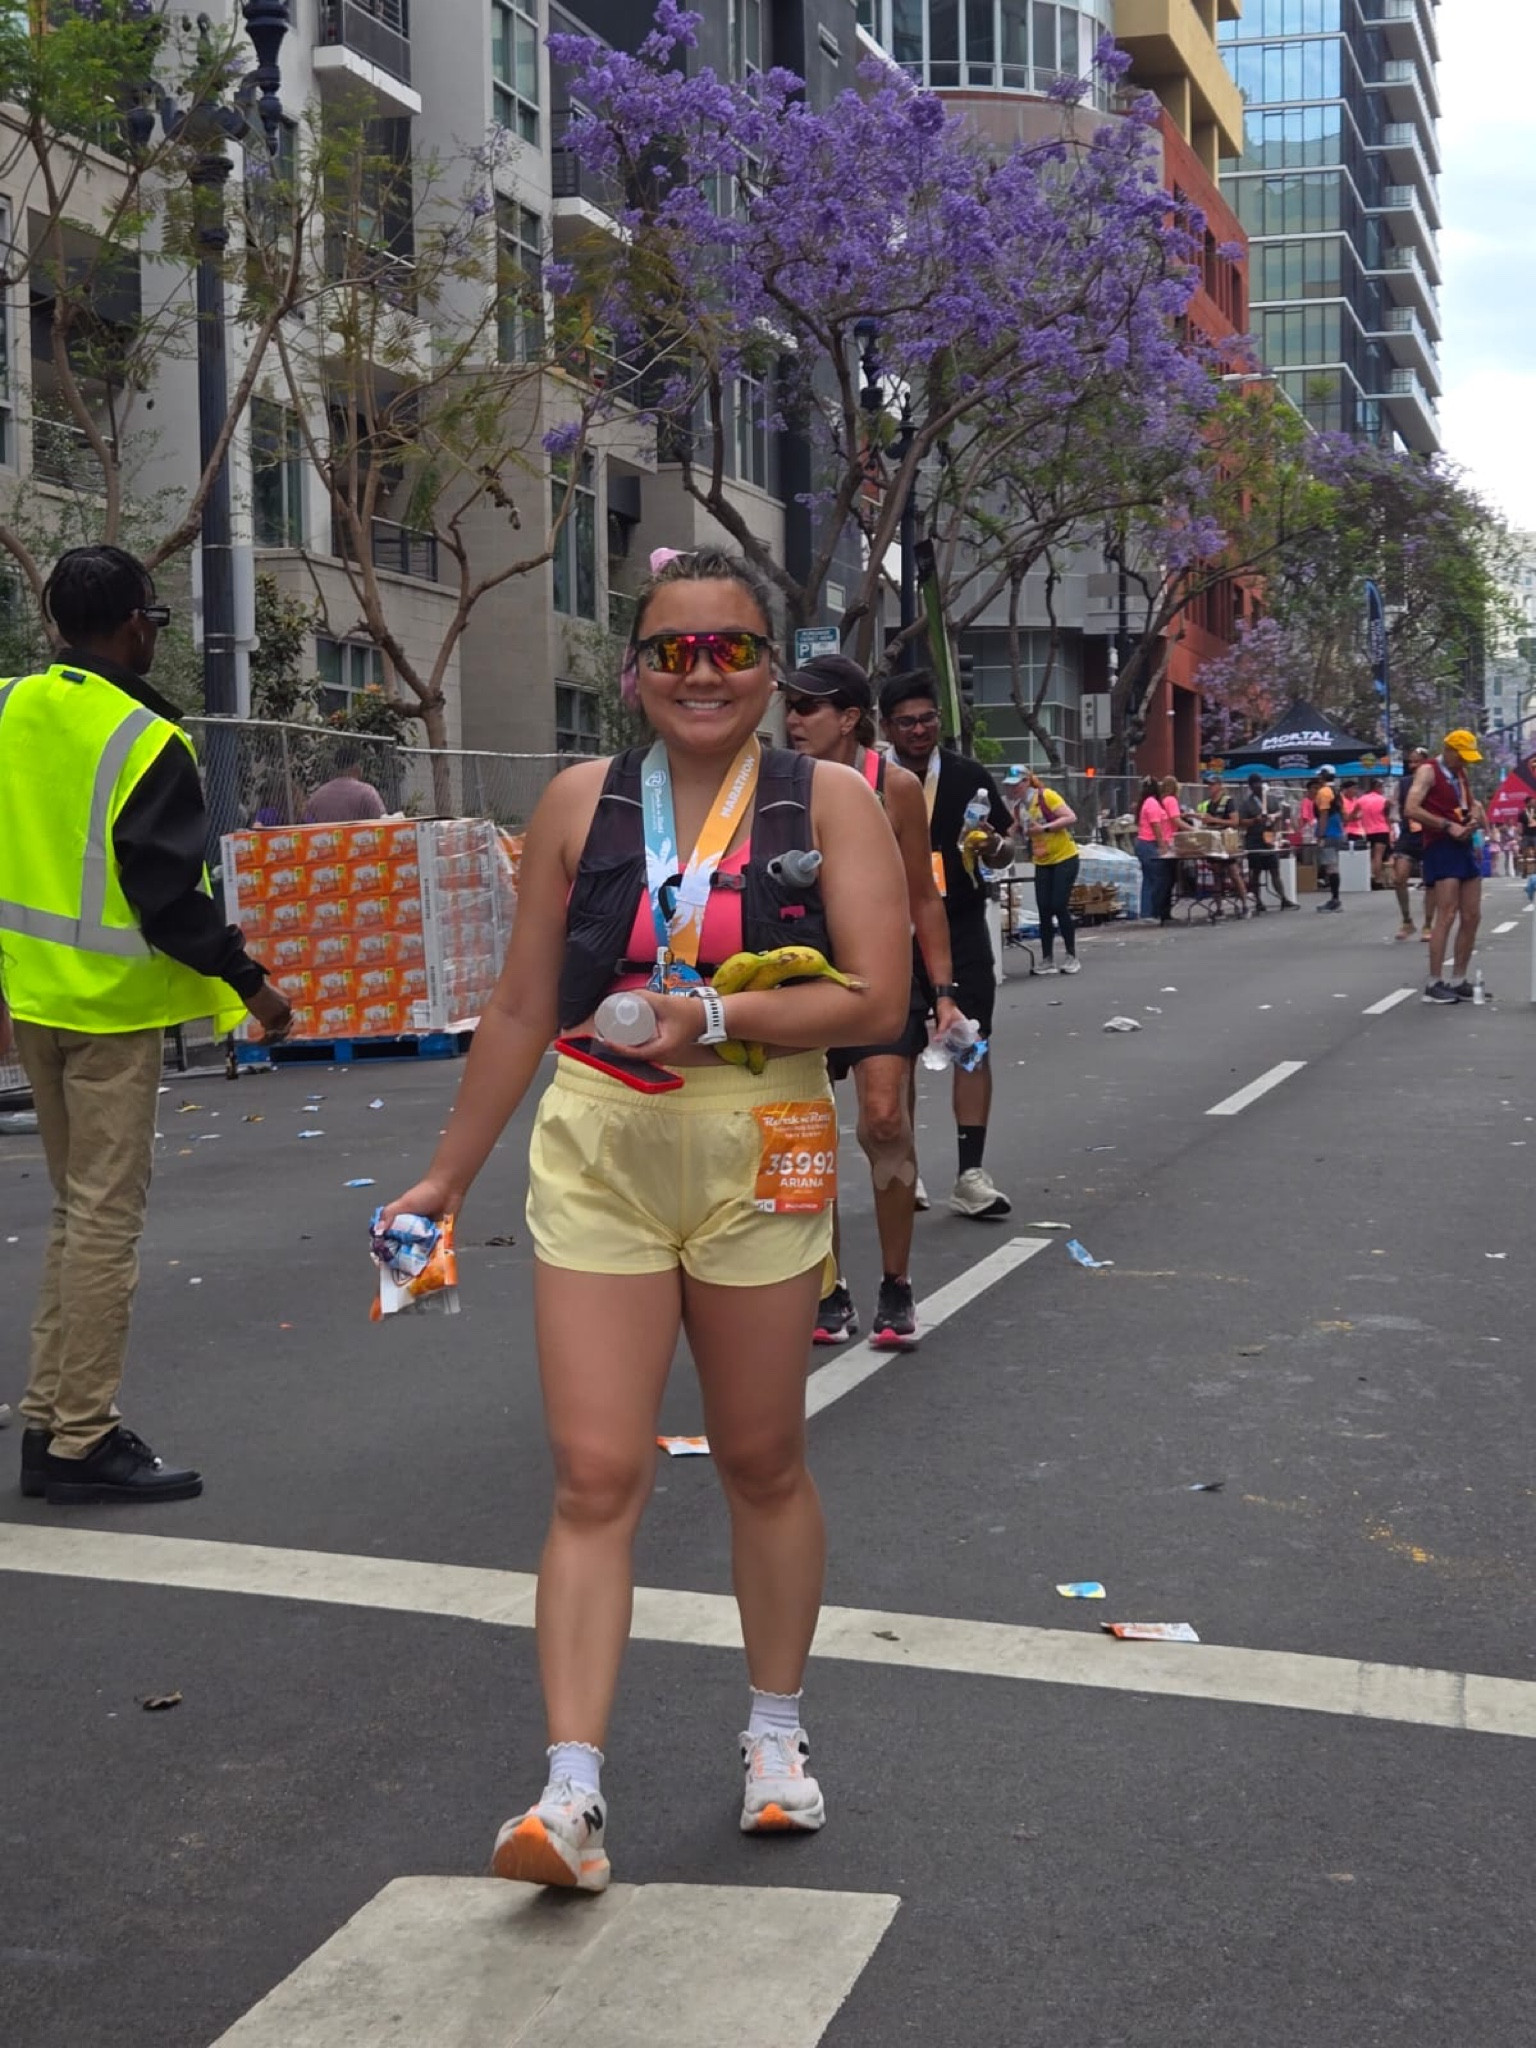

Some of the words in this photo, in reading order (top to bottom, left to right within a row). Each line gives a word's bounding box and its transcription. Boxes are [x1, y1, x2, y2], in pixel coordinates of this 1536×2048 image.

[1262, 731, 1334, 746] MORTAL
[720, 756, 755, 818] MARATHON
[765, 1151, 834, 1175] 36992
[780, 1177, 824, 1188] ARIANA
